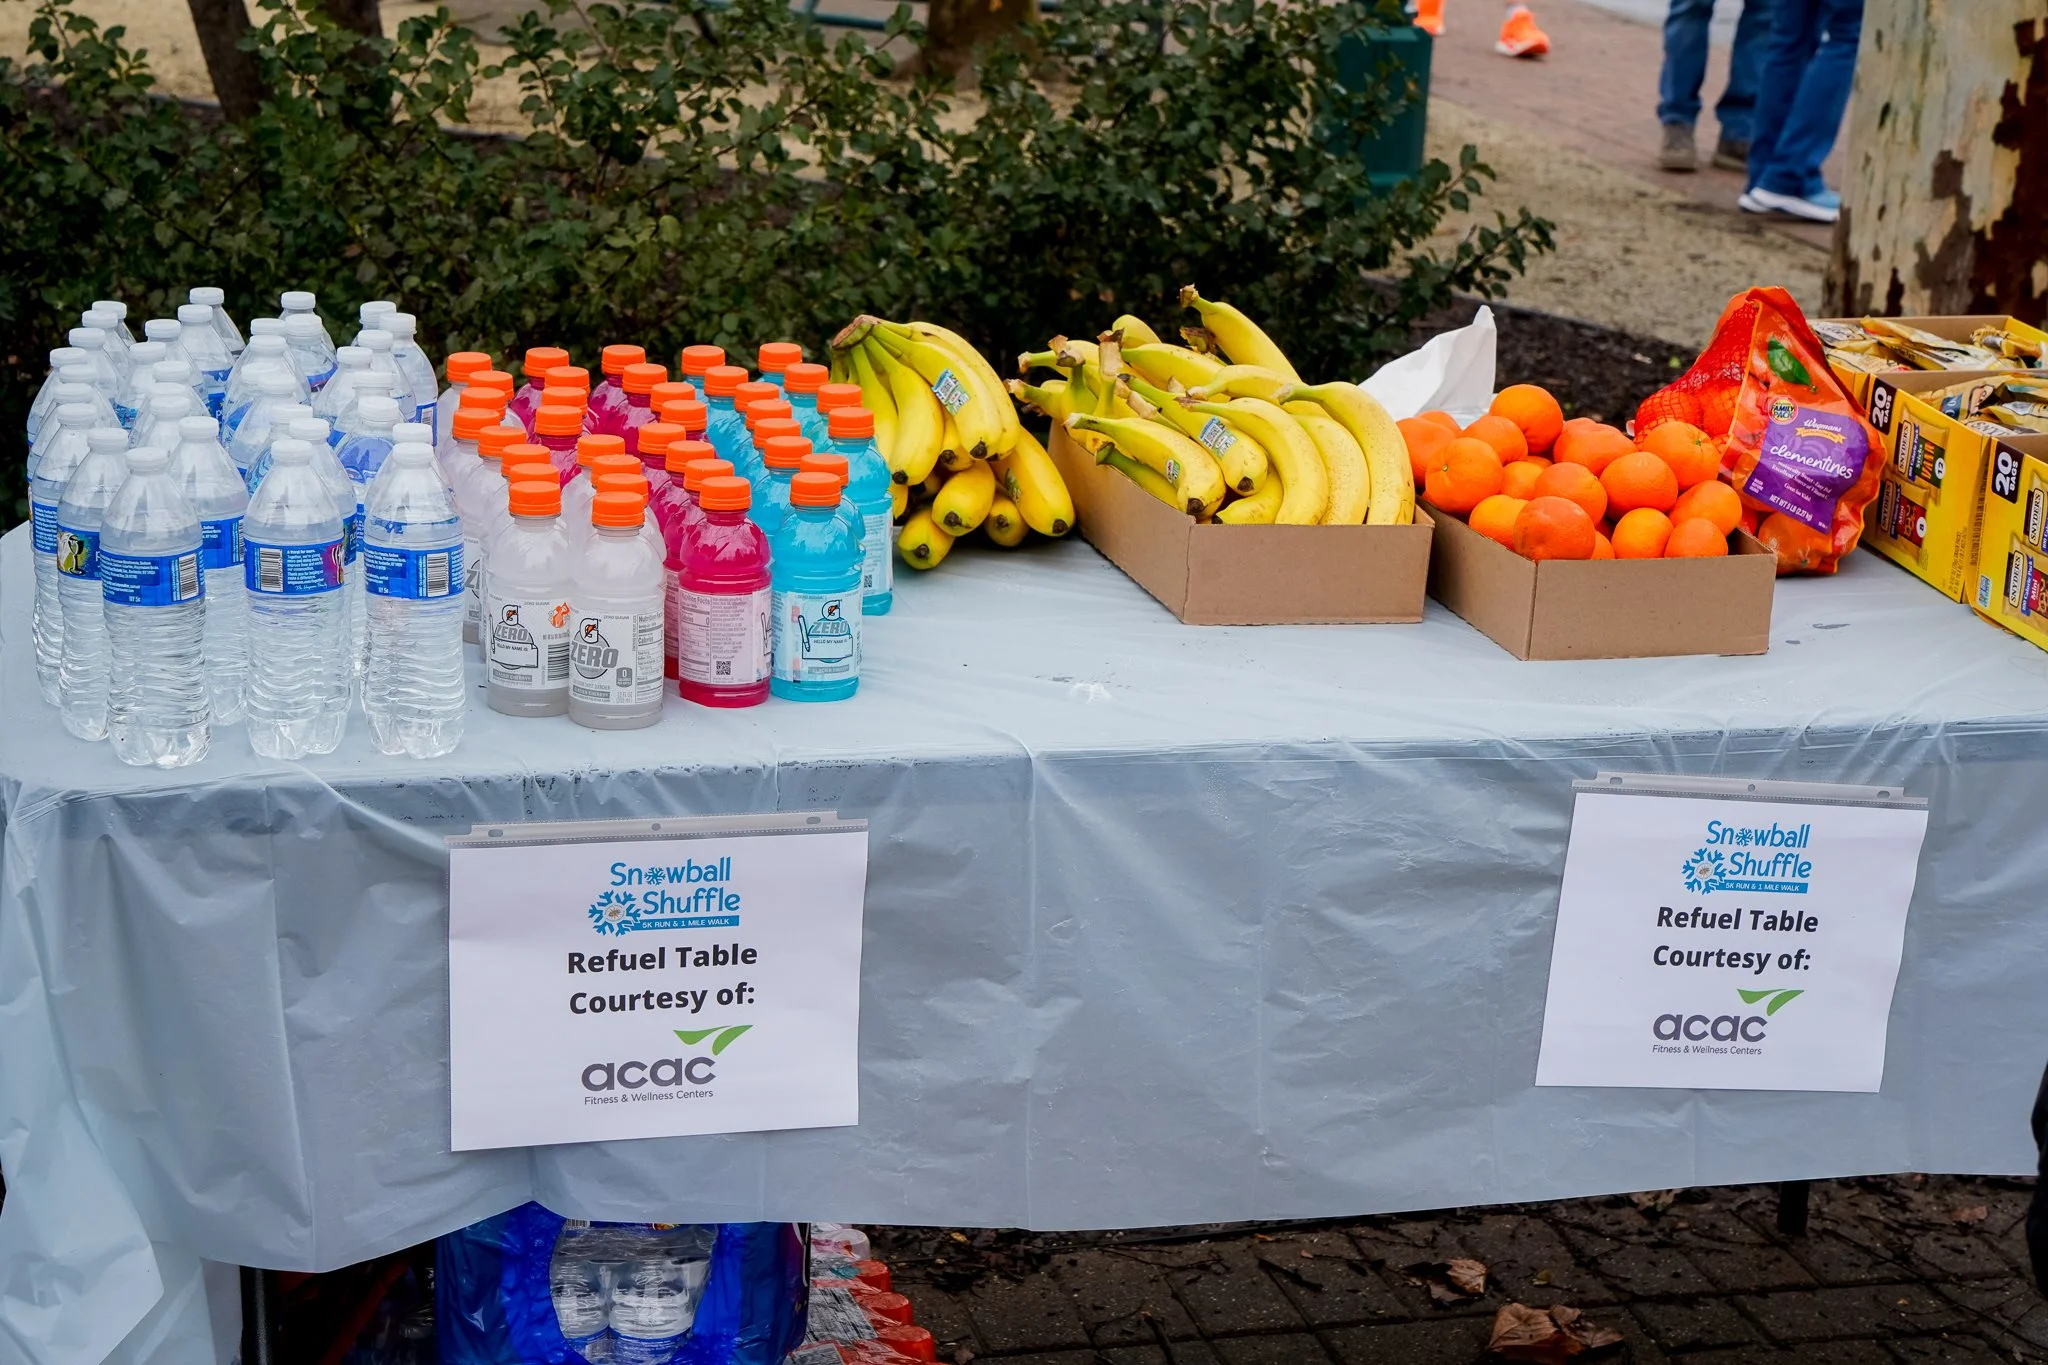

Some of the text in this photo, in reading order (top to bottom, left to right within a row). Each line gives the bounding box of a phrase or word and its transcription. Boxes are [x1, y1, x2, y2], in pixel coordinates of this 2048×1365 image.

[1773, 411, 1793, 419] PACK
[1872, 387, 1887, 428] 20
[1884, 395, 1892, 423] BAGS
[1804, 418, 1842, 433] Wegmans
[1770, 445, 1854, 479] clementines
[1937, 461, 1945, 474] 12
[1996, 452, 2012, 495] 20
[2010, 461, 2018, 491] BAGS
[1769, 494, 1780, 503] NET
[1779, 498, 1788, 507] WT
[1790, 504, 1797, 513] LB
[697, 596, 710, 604] Facts
[2024, 578, 2032, 599] Calorie
[639, 614, 656, 622] Nutrition
[812, 621, 848, 634] ZERO
[496, 625, 528, 641] ZERO
[571, 641, 619, 668] ZERO
[1729, 851, 1811, 879] Shuffle
[1737, 882, 1750, 890] RUN
[1781, 884, 1800, 892] WALK
[642, 888, 740, 916] Shuffle
[1657, 906, 1819, 933] Refuel Table
[568, 943, 757, 974] Refuel Table
[1653, 944, 1811, 975] Courtesy of:
[569, 982, 755, 1014] Courtesy of:
[1653, 1013, 1767, 1042] acac
[1652, 1044, 1761, 1055] Fitness & Wellness Centers
[581, 1055, 716, 1091] acac
[584, 1089, 713, 1105] Fitness & Wellness Centers
